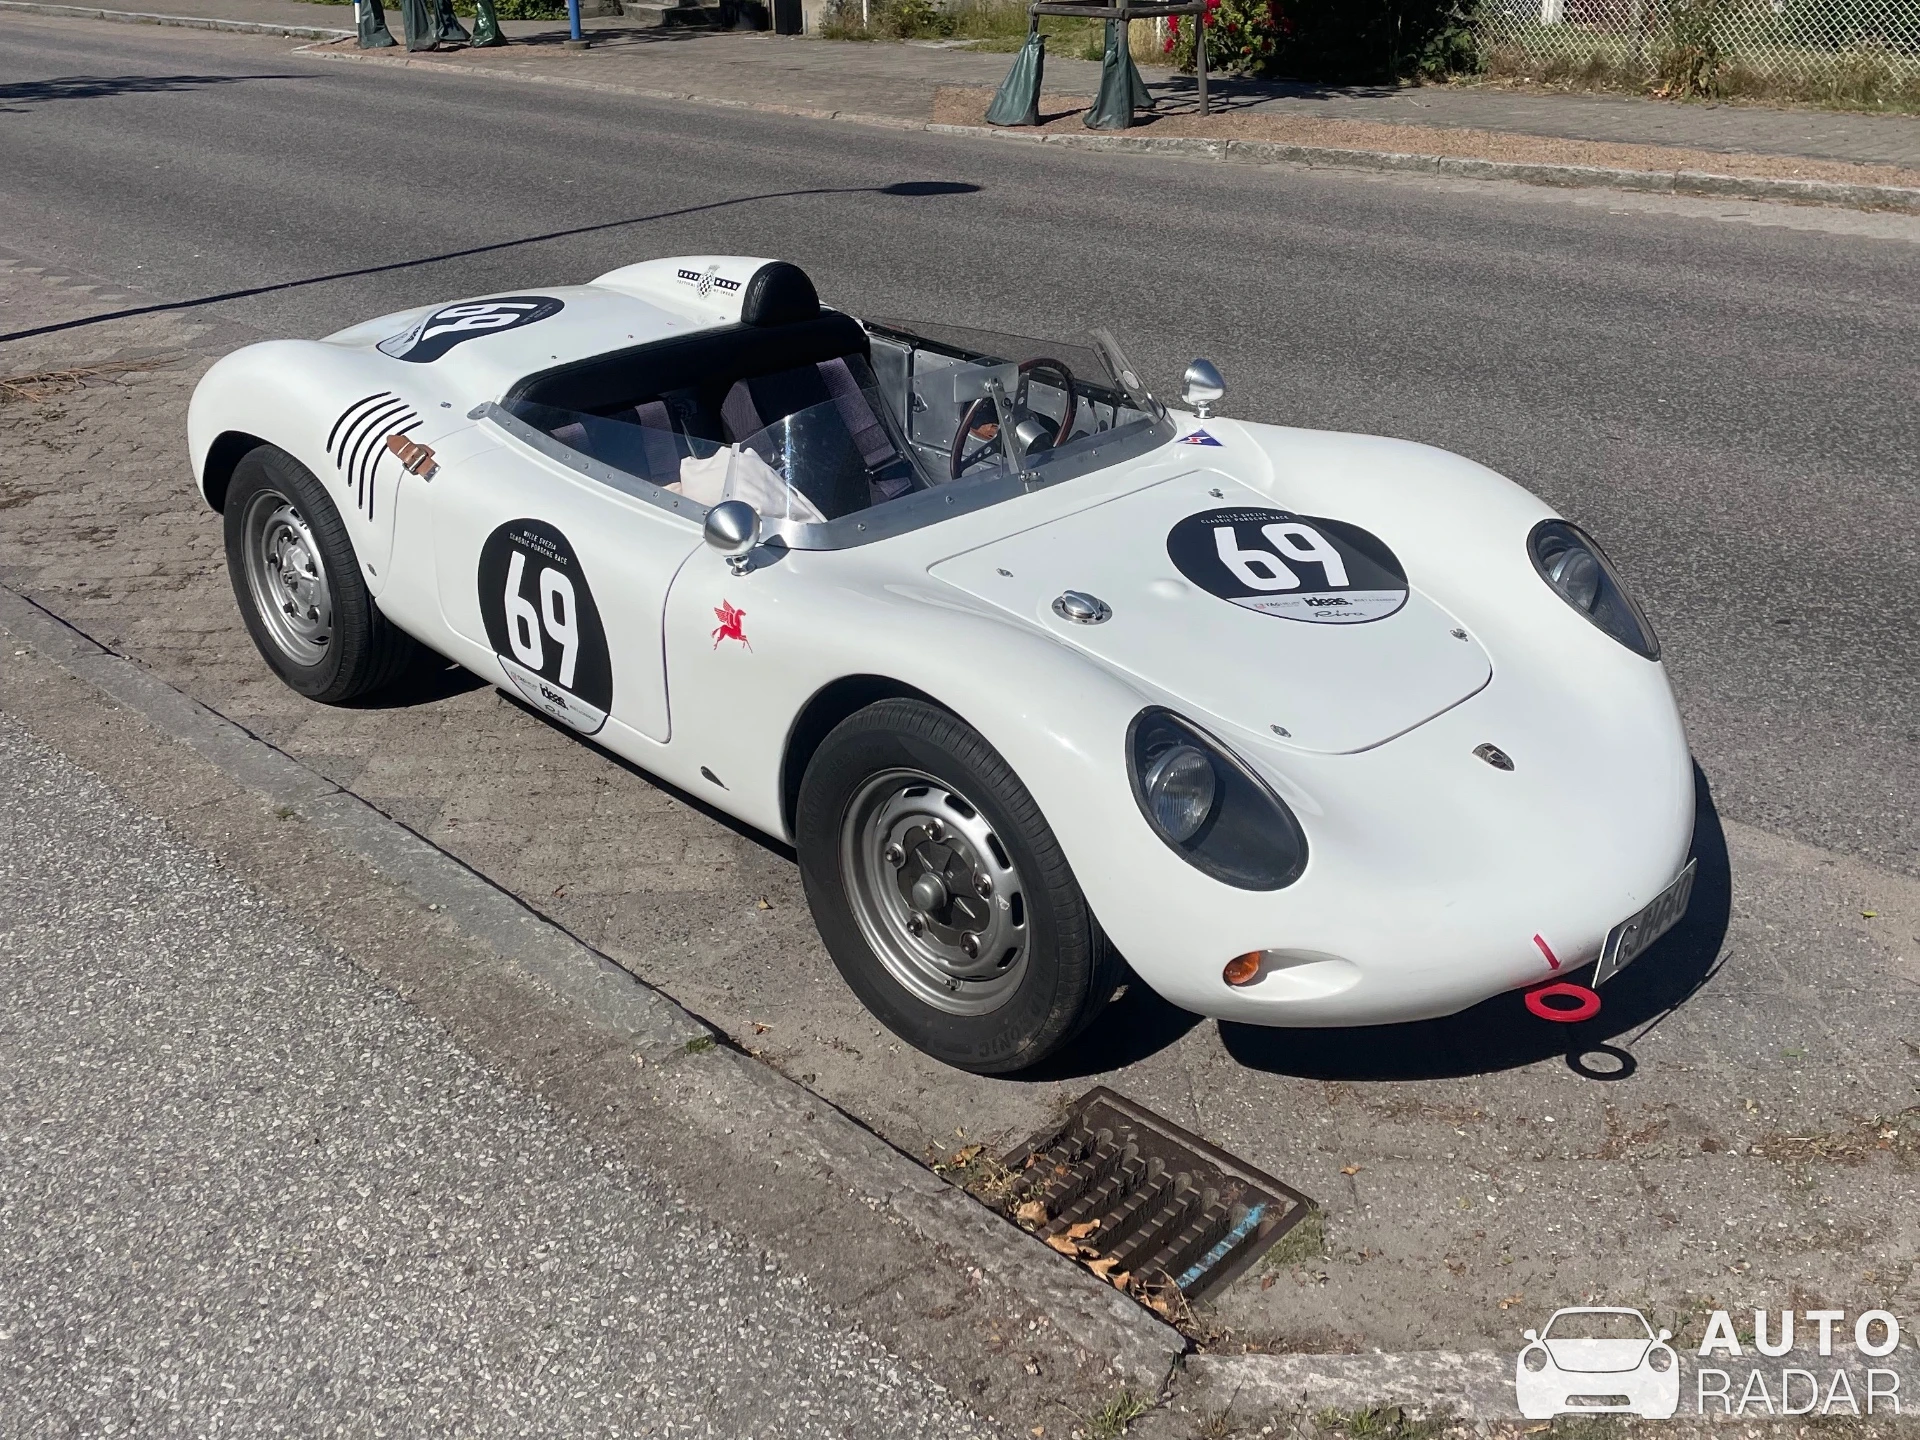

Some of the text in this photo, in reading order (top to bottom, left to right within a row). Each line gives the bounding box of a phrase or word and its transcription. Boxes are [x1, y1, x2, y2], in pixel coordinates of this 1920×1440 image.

[554, 553, 568, 565] RACE
[1213, 522, 1350, 591] 69
[504, 550, 579, 689] 69
